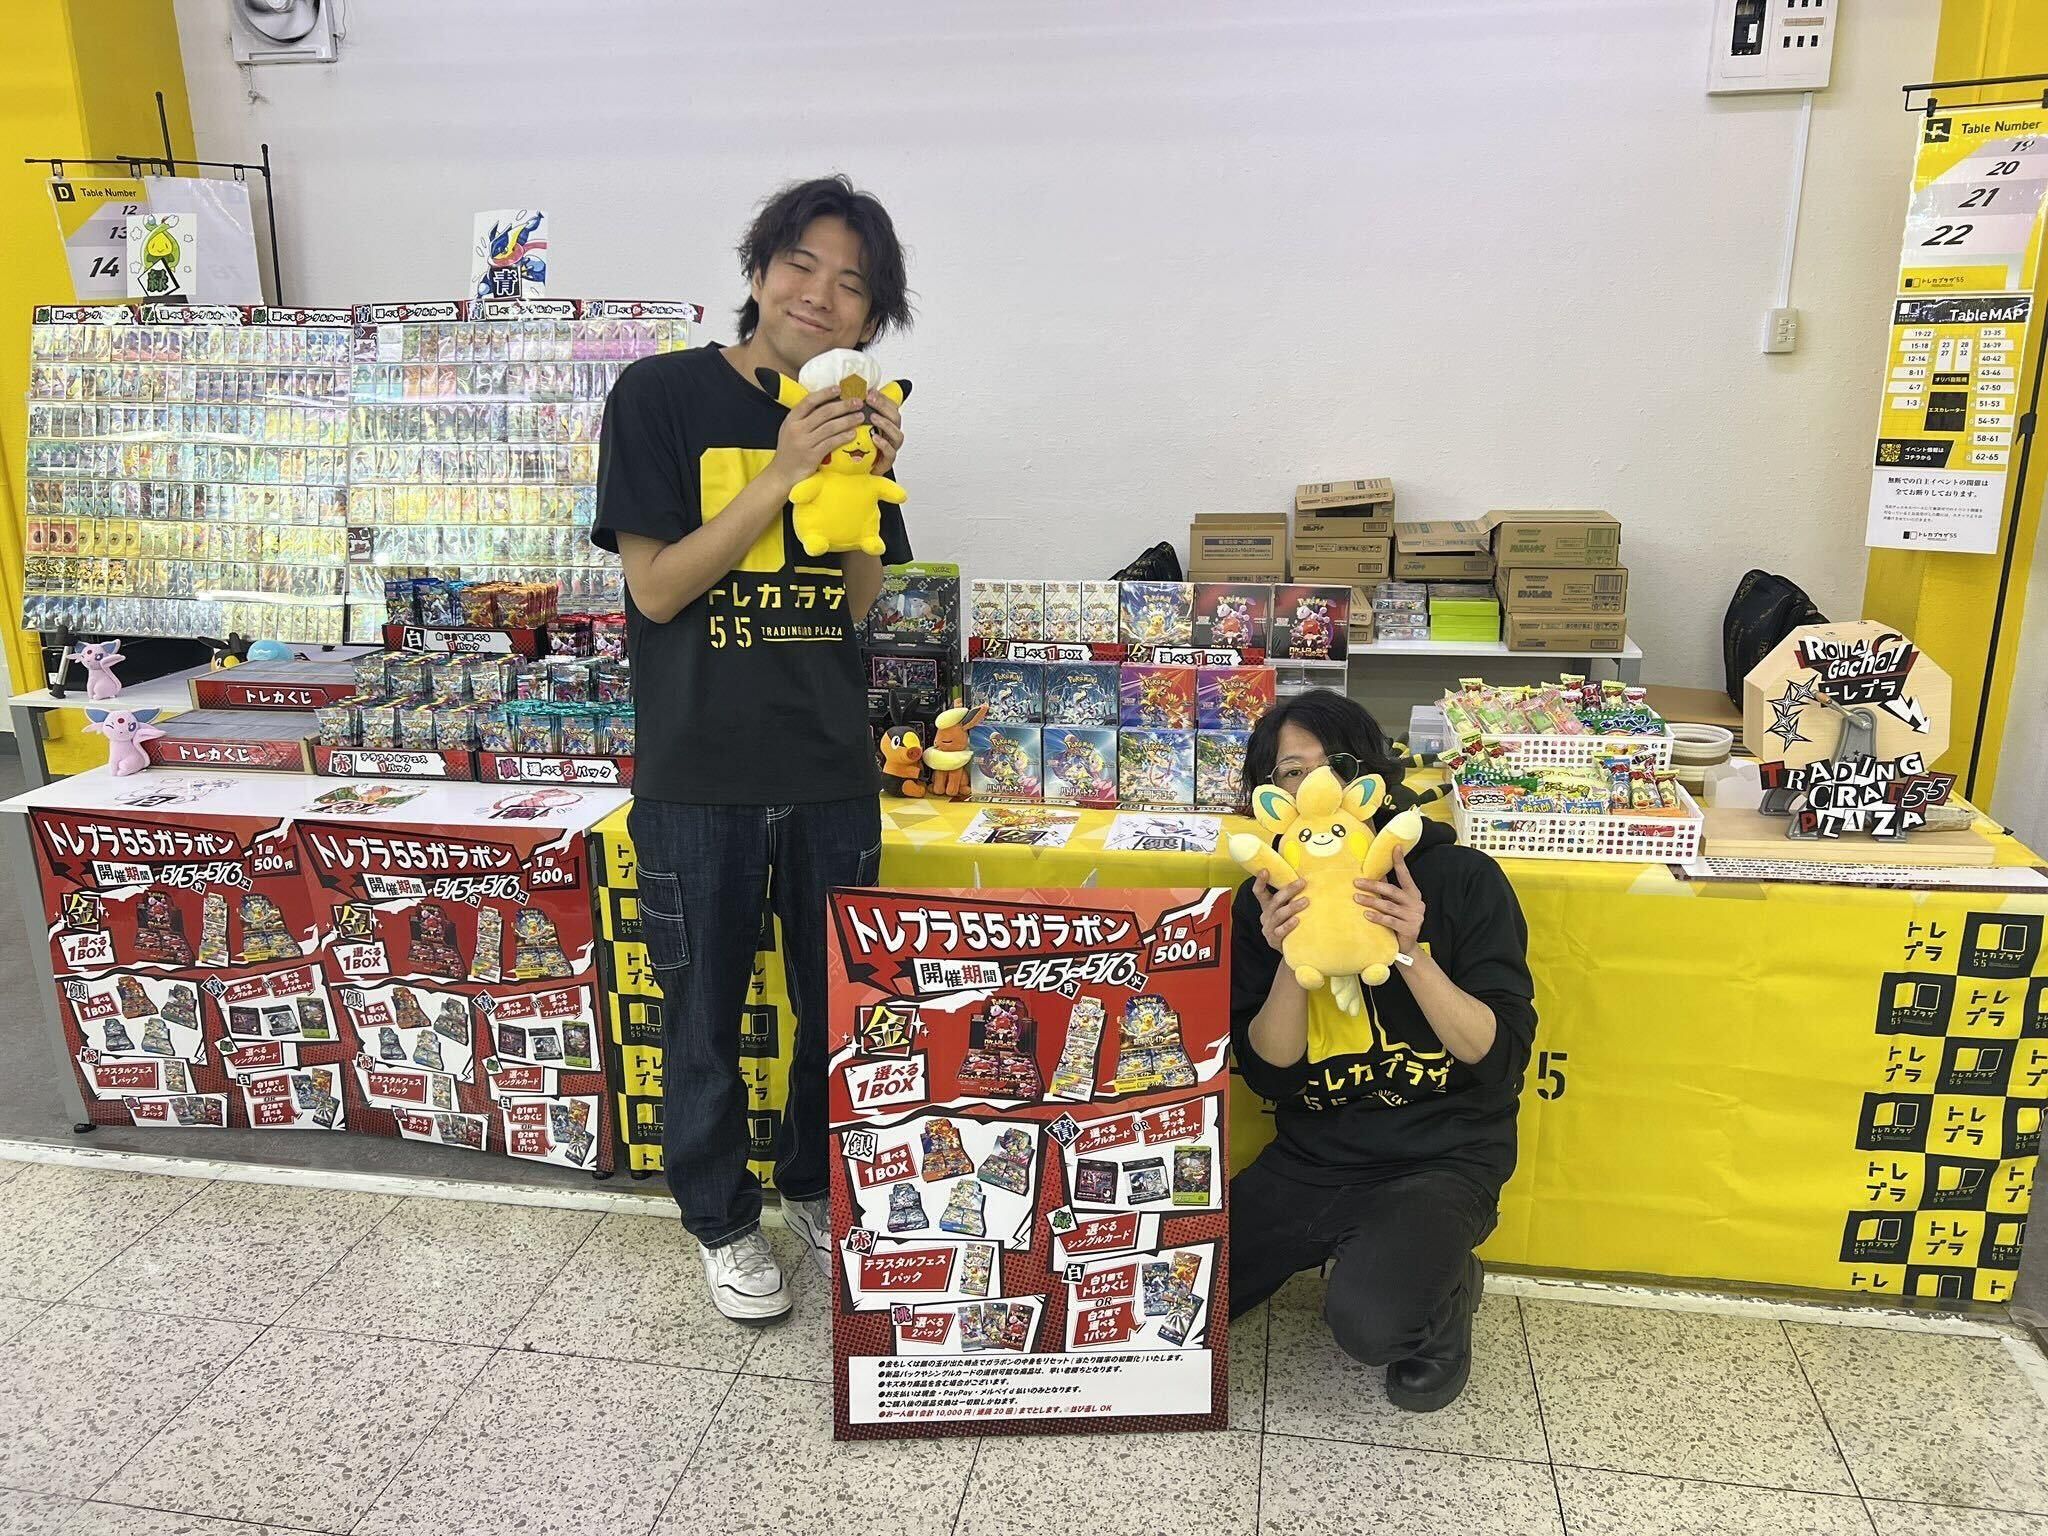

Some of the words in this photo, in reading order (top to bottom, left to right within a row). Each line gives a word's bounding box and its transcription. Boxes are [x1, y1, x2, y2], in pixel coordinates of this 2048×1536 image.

[1961, 122, 1991, 135] Table
[1994, 121, 2042, 133] Number
[1986, 160, 2021, 176] 20
[58, 186, 69, 199] D
[80, 188, 103, 198] Table
[105, 188, 137, 199] Number
[1957, 187, 2001, 208] 21
[122, 205, 138, 216] 12
[1920, 224, 1974, 246] 22
[89, 256, 120, 278] 14
[494, 271, 517, 295] 青
[356, 307, 372, 323] 青
[375, 306, 454, 319] 選べるシングルカード
[1977, 417, 2000, 425] 54-57
[1975, 453, 1999, 461] 62-65
[408, 631, 423, 648] 白
[710, 615, 752, 649] 55
[815, 626, 843, 637] PLAZA
[246, 689, 312, 704] トレカくじ
[179, 746, 250, 761] トレカくじ
[527, 762, 611, 780] 選べる2パック
[1760, 754, 1924, 792] TRADING
[1800, 810, 1924, 838] PLAZA
[44, 820, 234, 858] トレプラ55ガラポン
[310, 833, 513, 871] トレプラ55ガラポン
[254, 855, 294, 872] 500円
[99, 863, 150, 883] 開催期間
[531, 867, 574, 886] 500円
[368, 876, 423, 896] 開催期間
[67, 893, 98, 926] 金
[340, 905, 373, 935] 金
[846, 904, 1131, 955] トレプラ55ガラポン
[1161, 924, 1188, 942] 1回
[1907, 921, 1947, 939] トレ
[77, 936, 107, 949] 選べる
[1904, 941, 1943, 961] プラ
[67, 945, 107, 962] 1BOX
[352, 946, 382, 959] 選べる
[1153, 941, 1212, 965] 500円
[1974, 951, 2024, 961] トレカプラザ
[342, 955, 382, 972] 1BOX
[917, 963, 1000, 987] 開催期間
[1970, 990, 2011, 1005] トレ
[83, 1001, 114, 1018] 1BOX
[1966, 1007, 2006, 1027] プラ
[360, 1011, 389, 1026] 1BOX
[863, 1005, 911, 1050] 金
[1889, 1046, 1926, 1063] トレ
[873, 1062, 919, 1083] 選べる
[1885, 1064, 1922, 1083] プラ
[855, 1073, 916, 1102] 1BOX
[1158, 1107, 1187, 1124] 選べる
[1948, 1106, 1987, 1122] トレ
[1051, 1120, 1077, 1142] 青
[1089, 1124, 1117, 1139] 選べる
[1132, 1120, 1150, 1133] OR
[1148, 1122, 1200, 1143] ファイルセット
[1163, 1118, 1185, 1131] デッキ
[1079, 1130, 1131, 1151] シングルカード
[1943, 1125, 1984, 1145] プラ
[850, 1133, 873, 1158] 銀
[880, 1149, 908, 1165] 選べる
[865, 1161, 910, 1184] 1BOX
[1868, 1161, 1908, 1180] トレ
[1866, 1182, 1907, 1202] プラ
[1085, 1220, 1118, 1237] 選べる
[1930, 1221, 1968, 1237] トレ
[850, 1230, 872, 1251] 赤
[1067, 1229, 1132, 1250] シングルカード
[1926, 1239, 1965, 1256] プラ
[864, 1254, 947, 1270] テラスタルフェス
[880, 1271, 923, 1286] 1パック
[1067, 1264, 1083, 1282] 白
[1851, 1272, 1889, 1288] トレ
[1082, 1281, 1129, 1298] トレカくじ
[1095, 1296, 1113, 1308] OR
[914, 1315, 945, 1329] 選べる
[1088, 1318, 1115, 1332] 選べる
[911, 1325, 943, 1338] 2パック
[1083, 1328, 1118, 1342] 1パック
